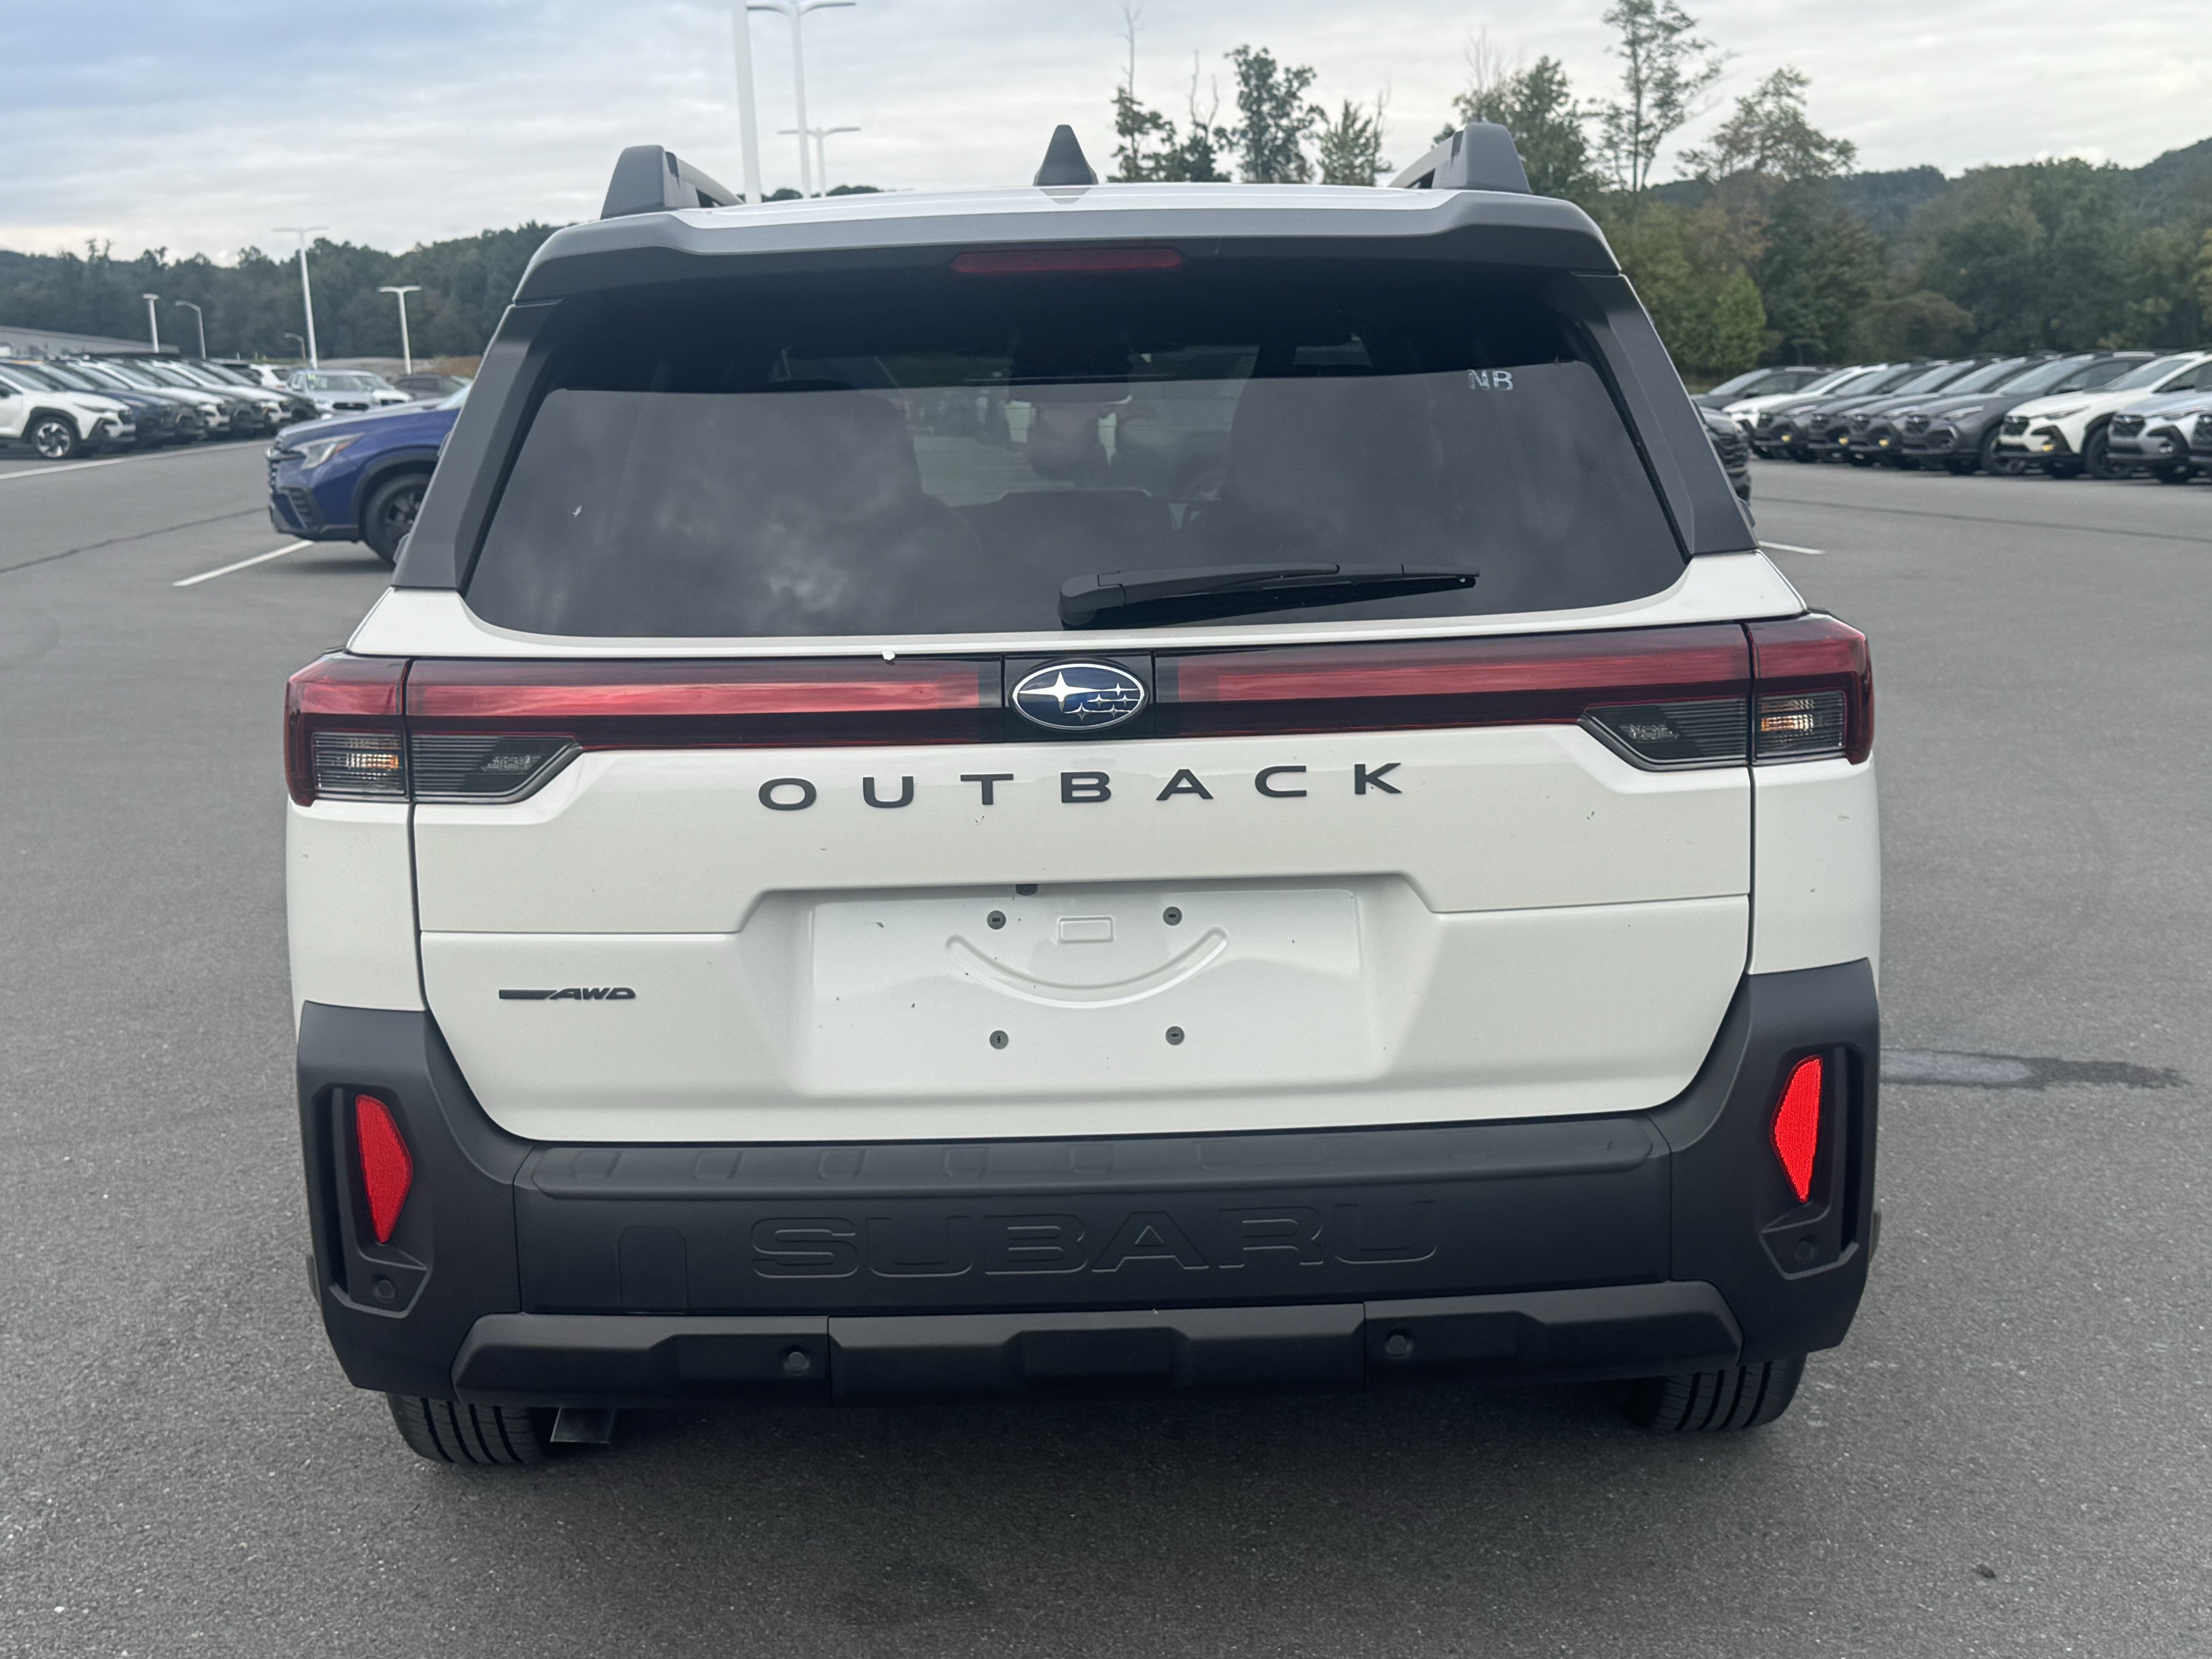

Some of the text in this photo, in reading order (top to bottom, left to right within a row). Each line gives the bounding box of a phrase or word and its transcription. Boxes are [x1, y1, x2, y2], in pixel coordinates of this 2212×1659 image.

[1467, 369, 1513, 391] NB
[759, 763, 1402, 811] OUTBACK
[549, 987, 636, 1000] AWD
[750, 1200, 1438, 1278] SUBARU
